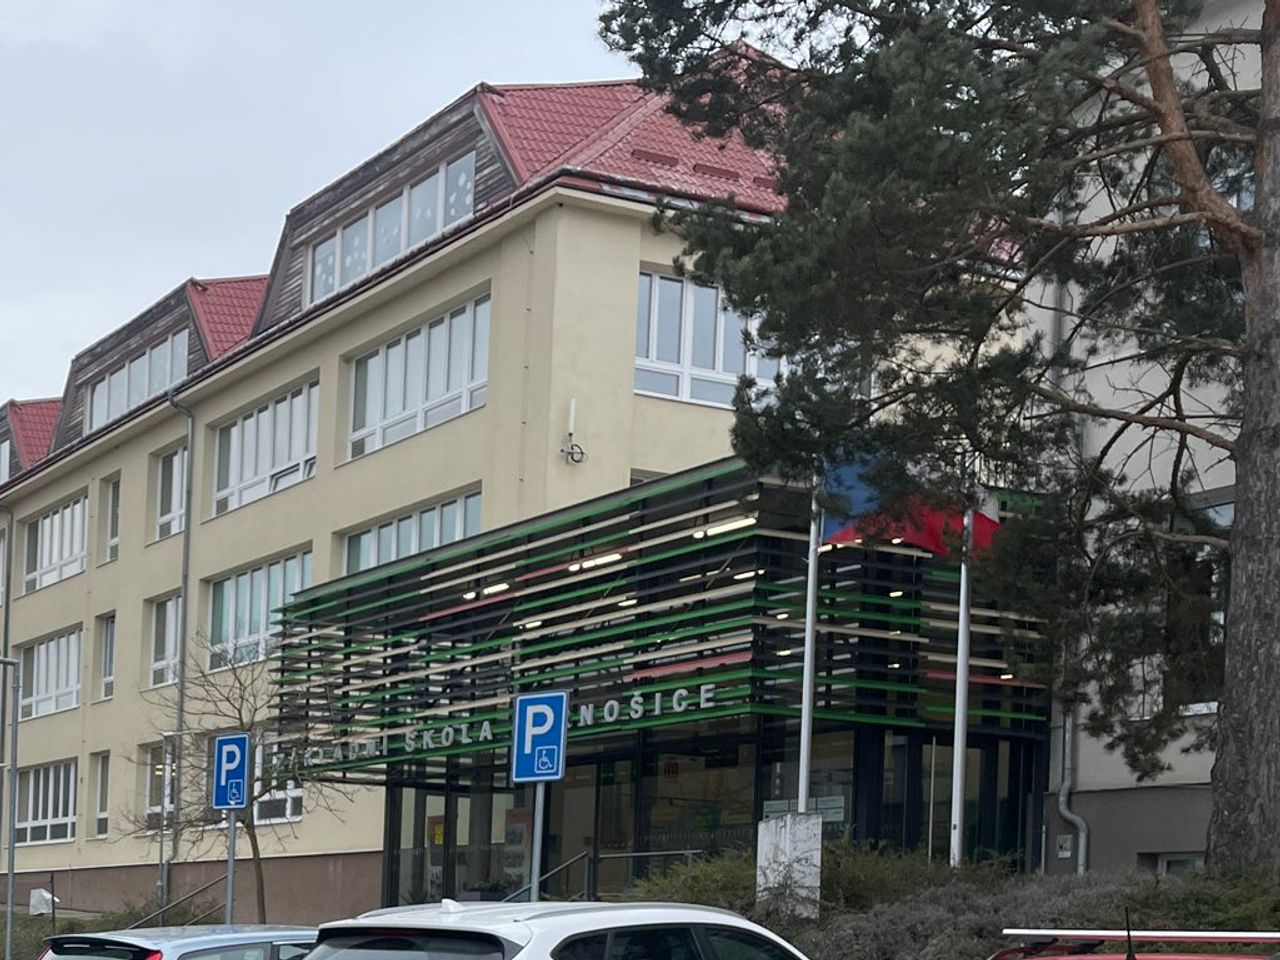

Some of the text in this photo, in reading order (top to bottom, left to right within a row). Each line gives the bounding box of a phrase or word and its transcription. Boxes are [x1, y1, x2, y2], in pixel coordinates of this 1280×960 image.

[404, 720, 493, 752] ŠKOLA
[523, 703, 555, 754] P
[220, 744, 241, 786] P
